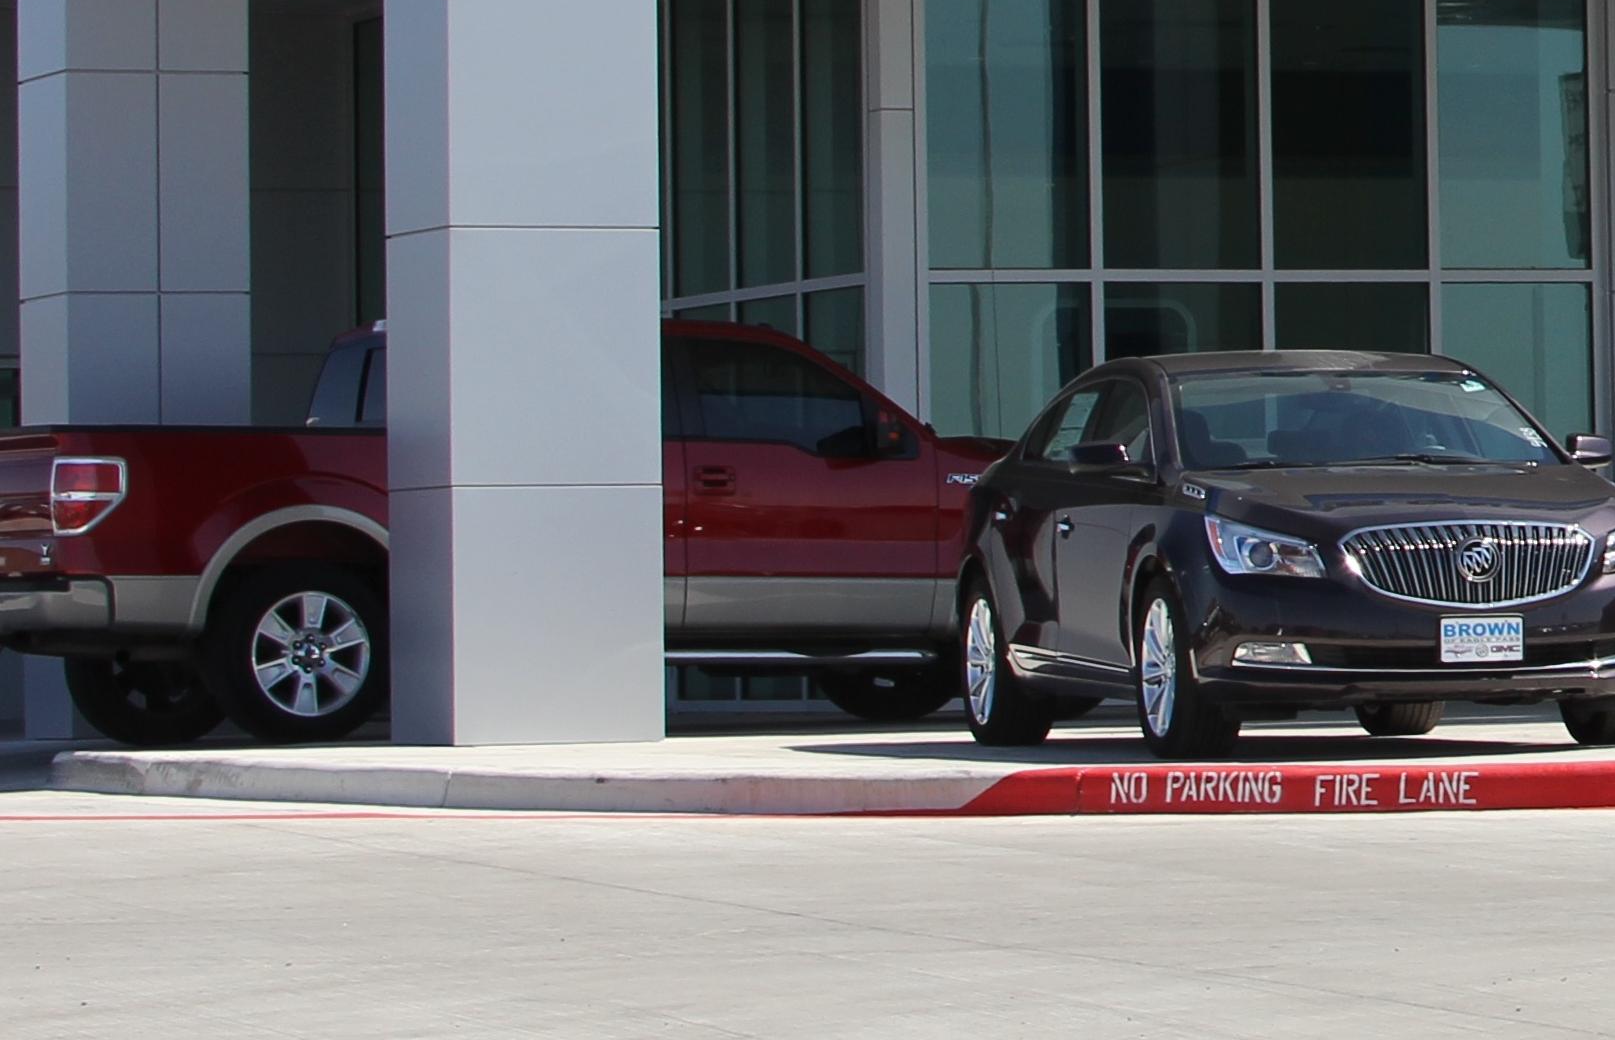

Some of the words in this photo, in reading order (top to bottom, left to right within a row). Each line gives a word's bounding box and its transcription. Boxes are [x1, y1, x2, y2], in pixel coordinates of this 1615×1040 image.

[1443, 623, 1521, 637] BROWN
[1490, 645, 1521, 653] GMC
[1110, 772, 1148, 804] NO
[1165, 771, 1282, 804] PARKING
[1314, 773, 1381, 807] FIRE
[1399, 772, 1480, 804] LANE
